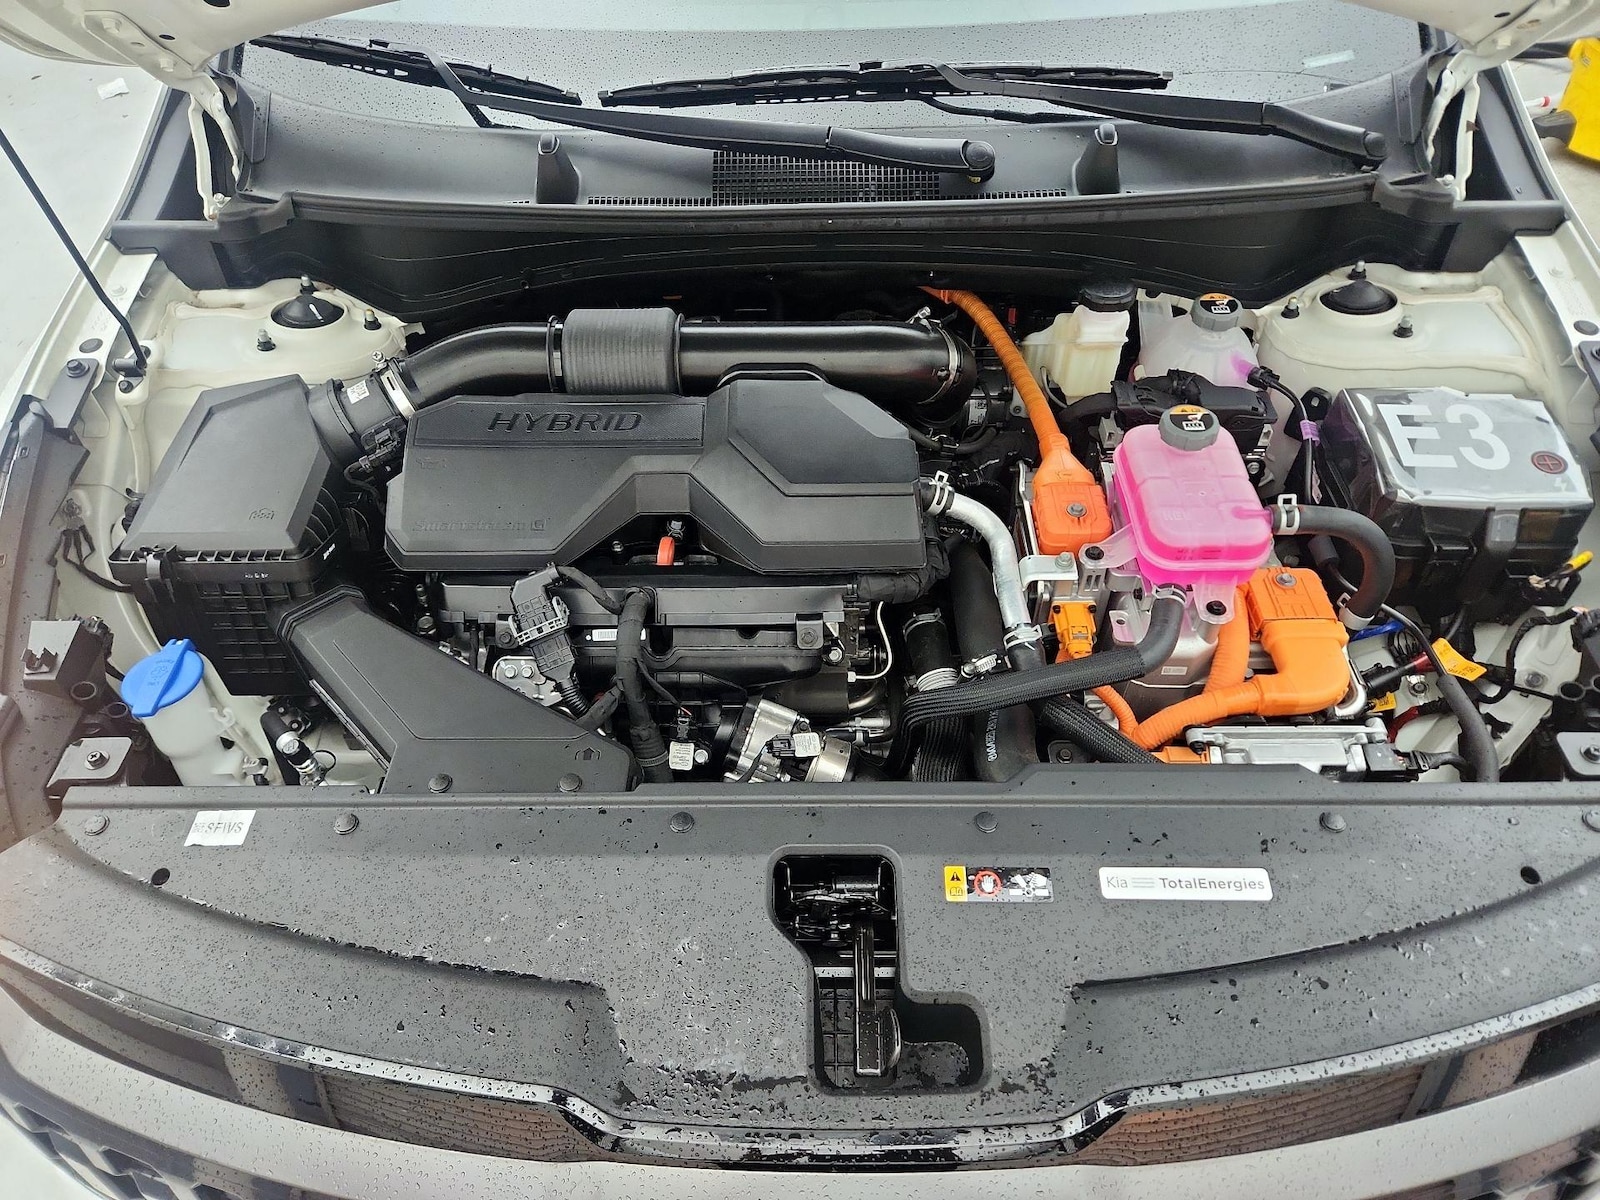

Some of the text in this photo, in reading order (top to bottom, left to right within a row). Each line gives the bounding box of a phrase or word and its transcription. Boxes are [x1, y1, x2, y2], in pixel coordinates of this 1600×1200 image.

[487, 410, 643, 433] HYBRID
[1376, 403, 1511, 470] E3
[1106, 876, 1265, 892] Kia TotalEnergies
